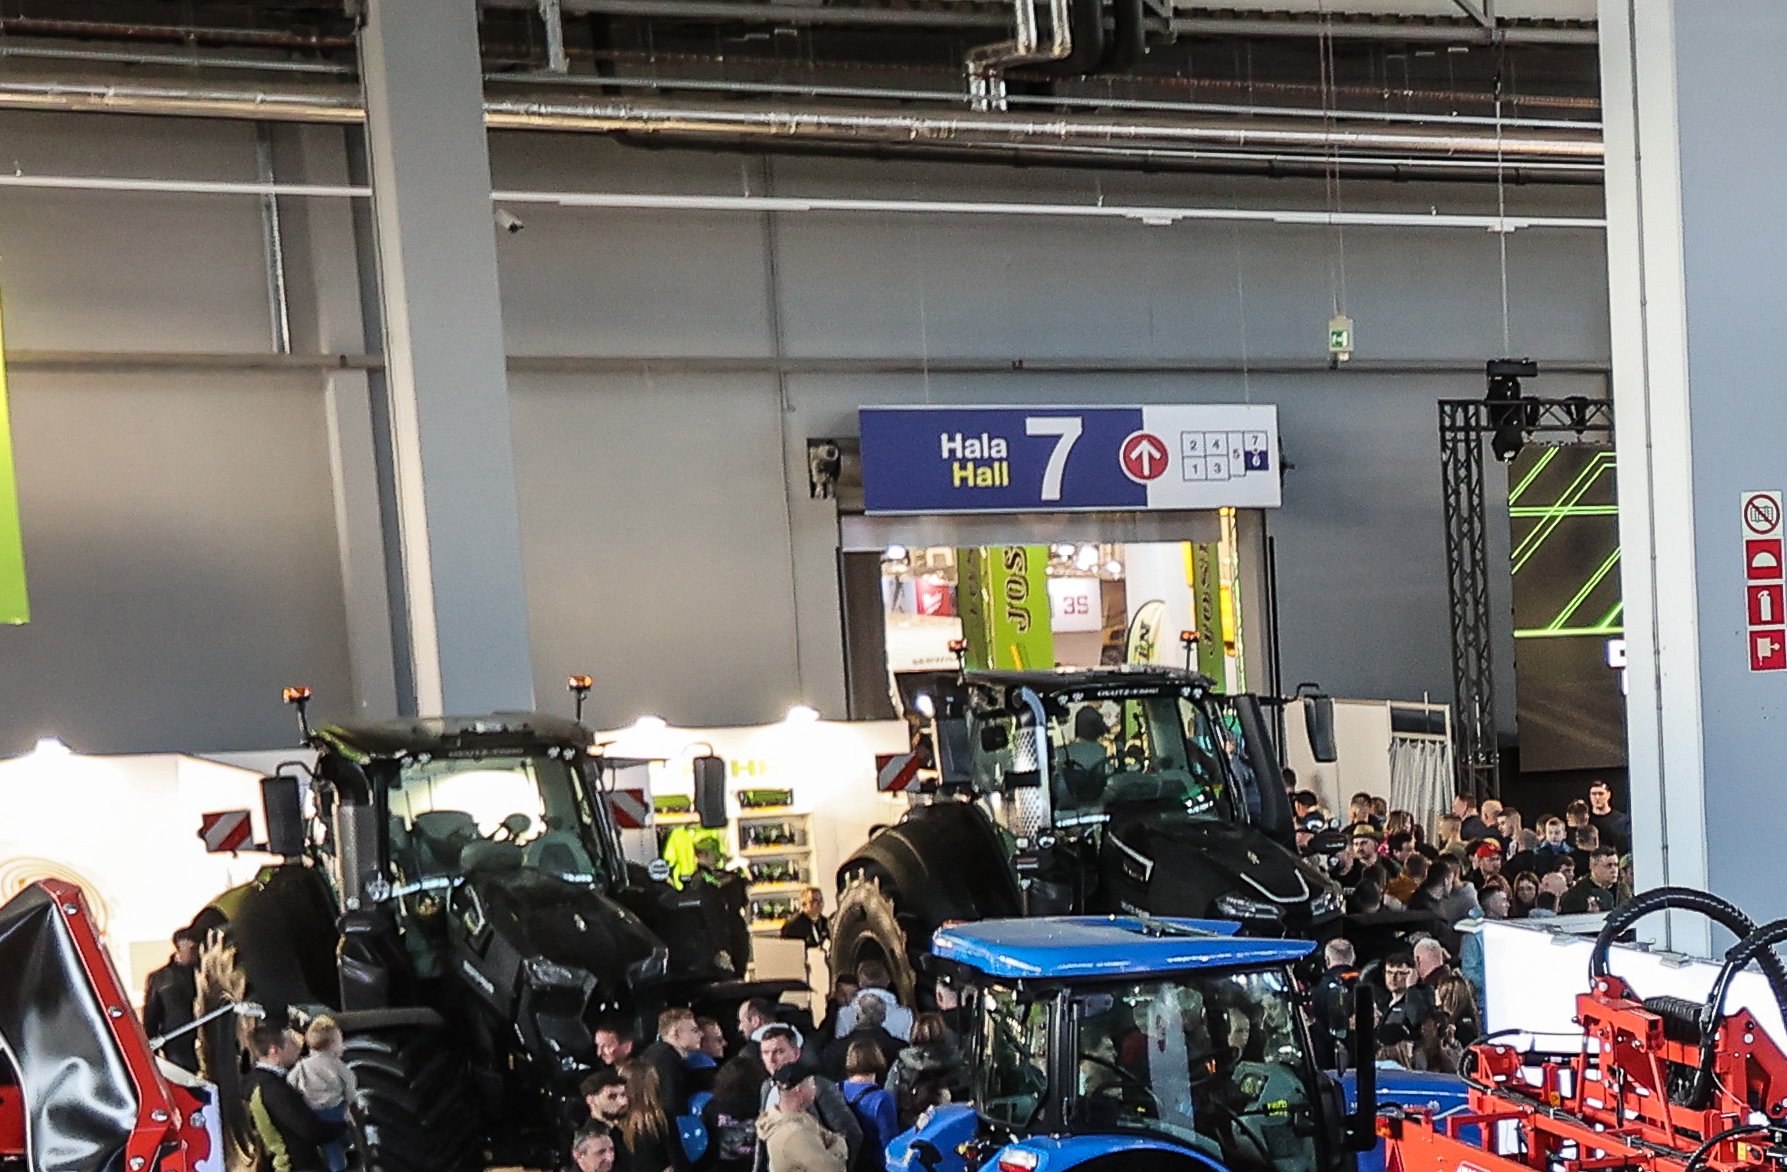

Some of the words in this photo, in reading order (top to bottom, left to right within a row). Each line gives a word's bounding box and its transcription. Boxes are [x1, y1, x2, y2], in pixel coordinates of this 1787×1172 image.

[1212, 438, 1221, 451] 4
[1251, 434, 1259, 446] 7
[940, 431, 1008, 460] Hala
[1025, 416, 1083, 501] 7
[952, 461, 1010, 488] Hall
